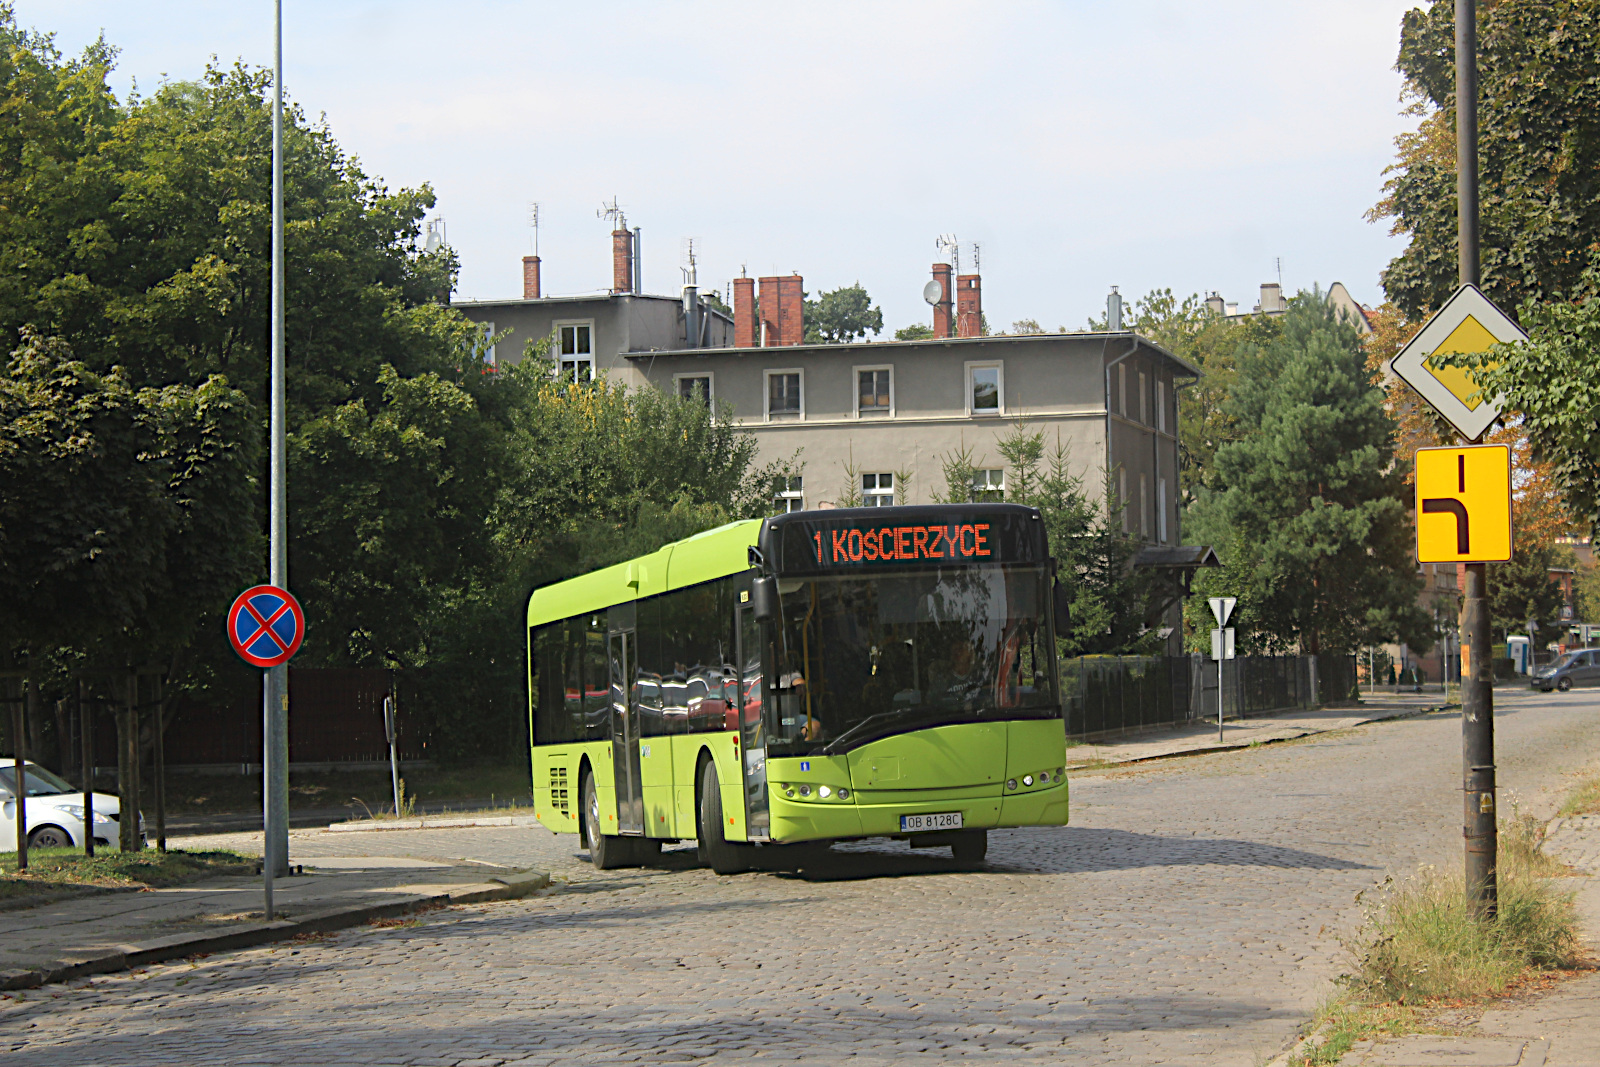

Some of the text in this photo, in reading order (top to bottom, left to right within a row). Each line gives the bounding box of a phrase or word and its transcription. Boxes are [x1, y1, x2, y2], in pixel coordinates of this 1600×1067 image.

[813, 523, 991, 563] 1 KOŚCIERZYCE
[908, 815, 959, 828] OB 8128C
